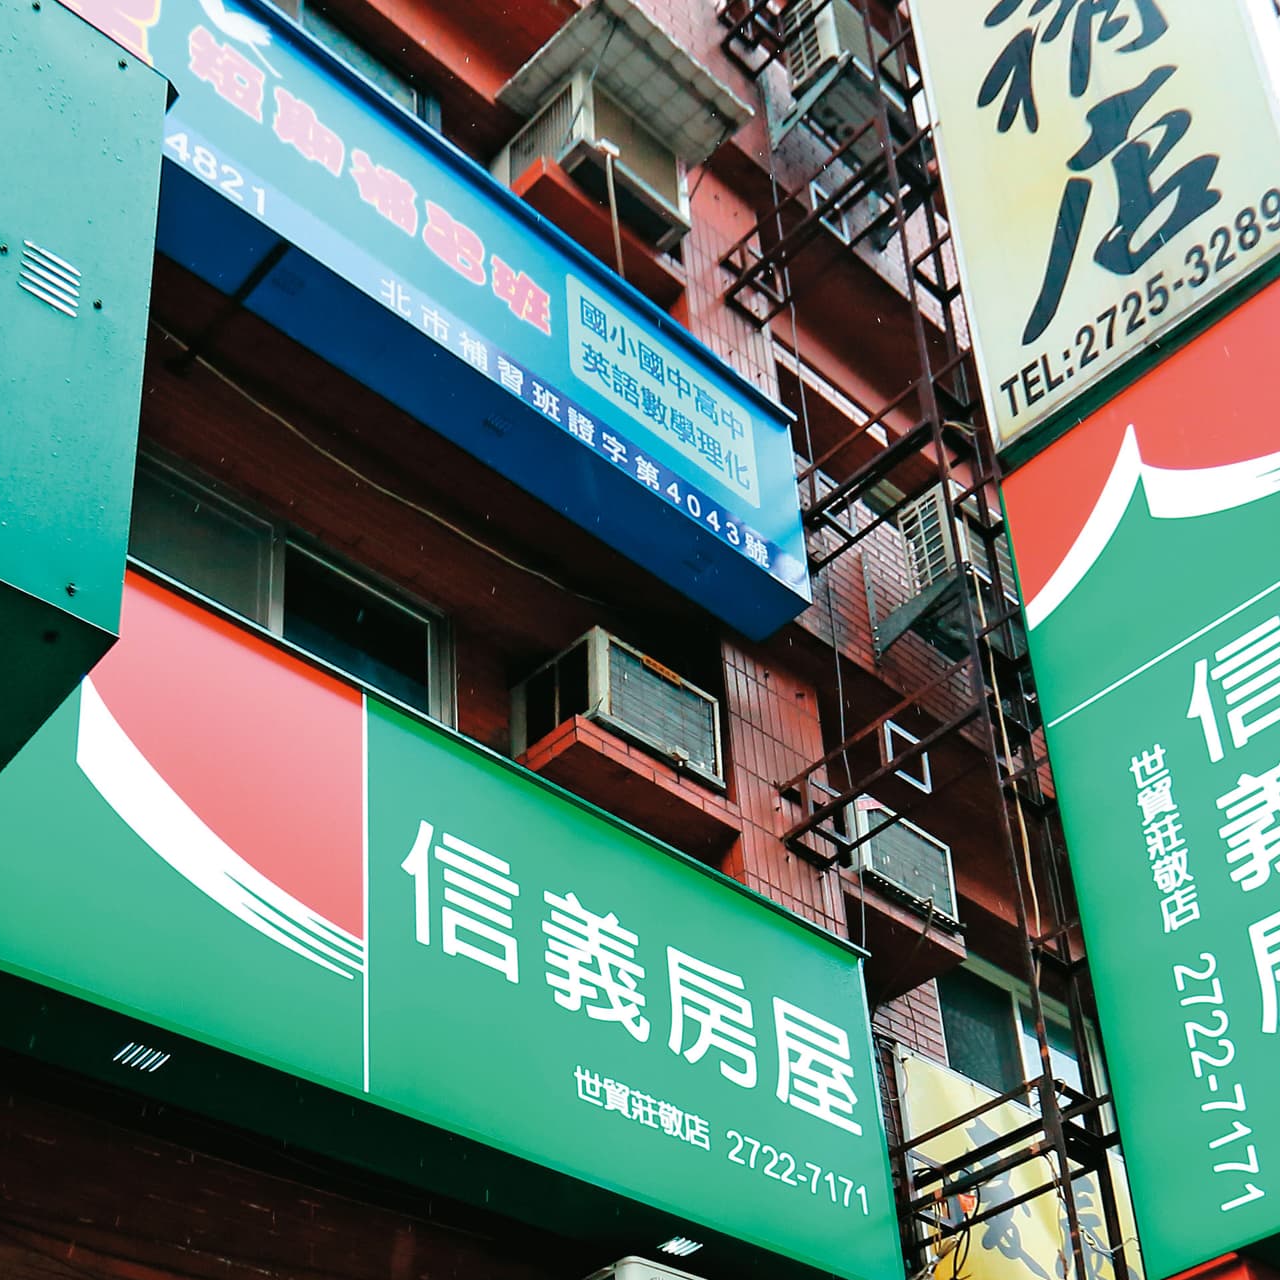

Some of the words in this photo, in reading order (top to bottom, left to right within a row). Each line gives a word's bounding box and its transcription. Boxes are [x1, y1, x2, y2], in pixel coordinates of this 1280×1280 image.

[578, 296, 745, 441] 國小國中高中
[580, 342, 751, 491] 英語數學理化
[400, 819, 863, 1137] 信義房屋
[1129, 742, 1201, 935] 世貿莊敬店
[1172, 951, 1266, 1212] 2722-7171
[572, 1065, 712, 1152] 世貿莊敬店
[724, 1130, 871, 1217] 2722-7171
